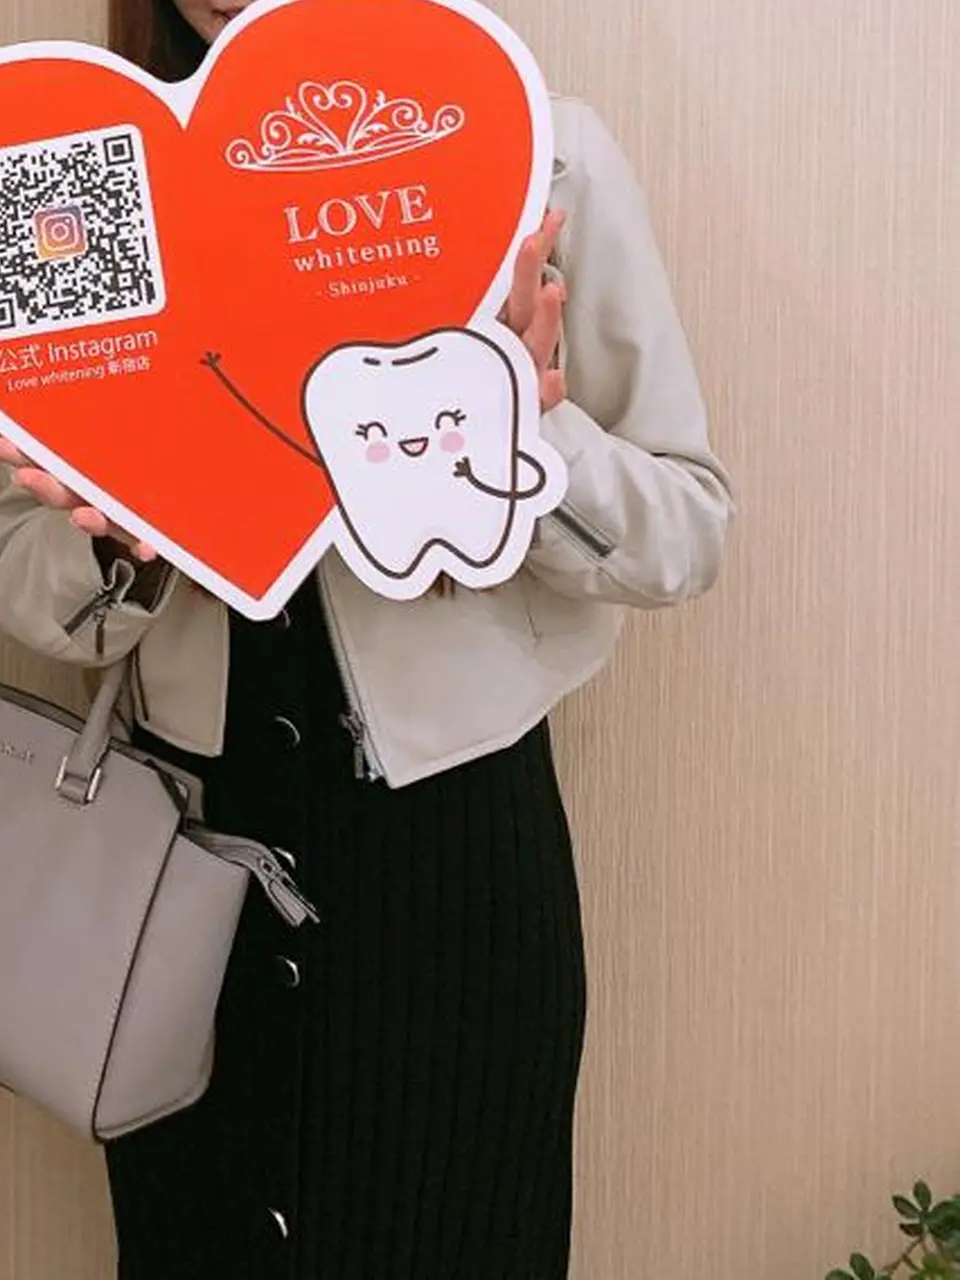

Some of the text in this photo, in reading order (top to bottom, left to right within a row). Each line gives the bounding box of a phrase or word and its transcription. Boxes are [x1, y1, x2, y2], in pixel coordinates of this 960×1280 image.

[284, 185, 433, 244] LOVE
[294, 235, 440, 272] whitening
[48, 330, 158, 363] Instagram
[7, 376, 39, 392] Love
